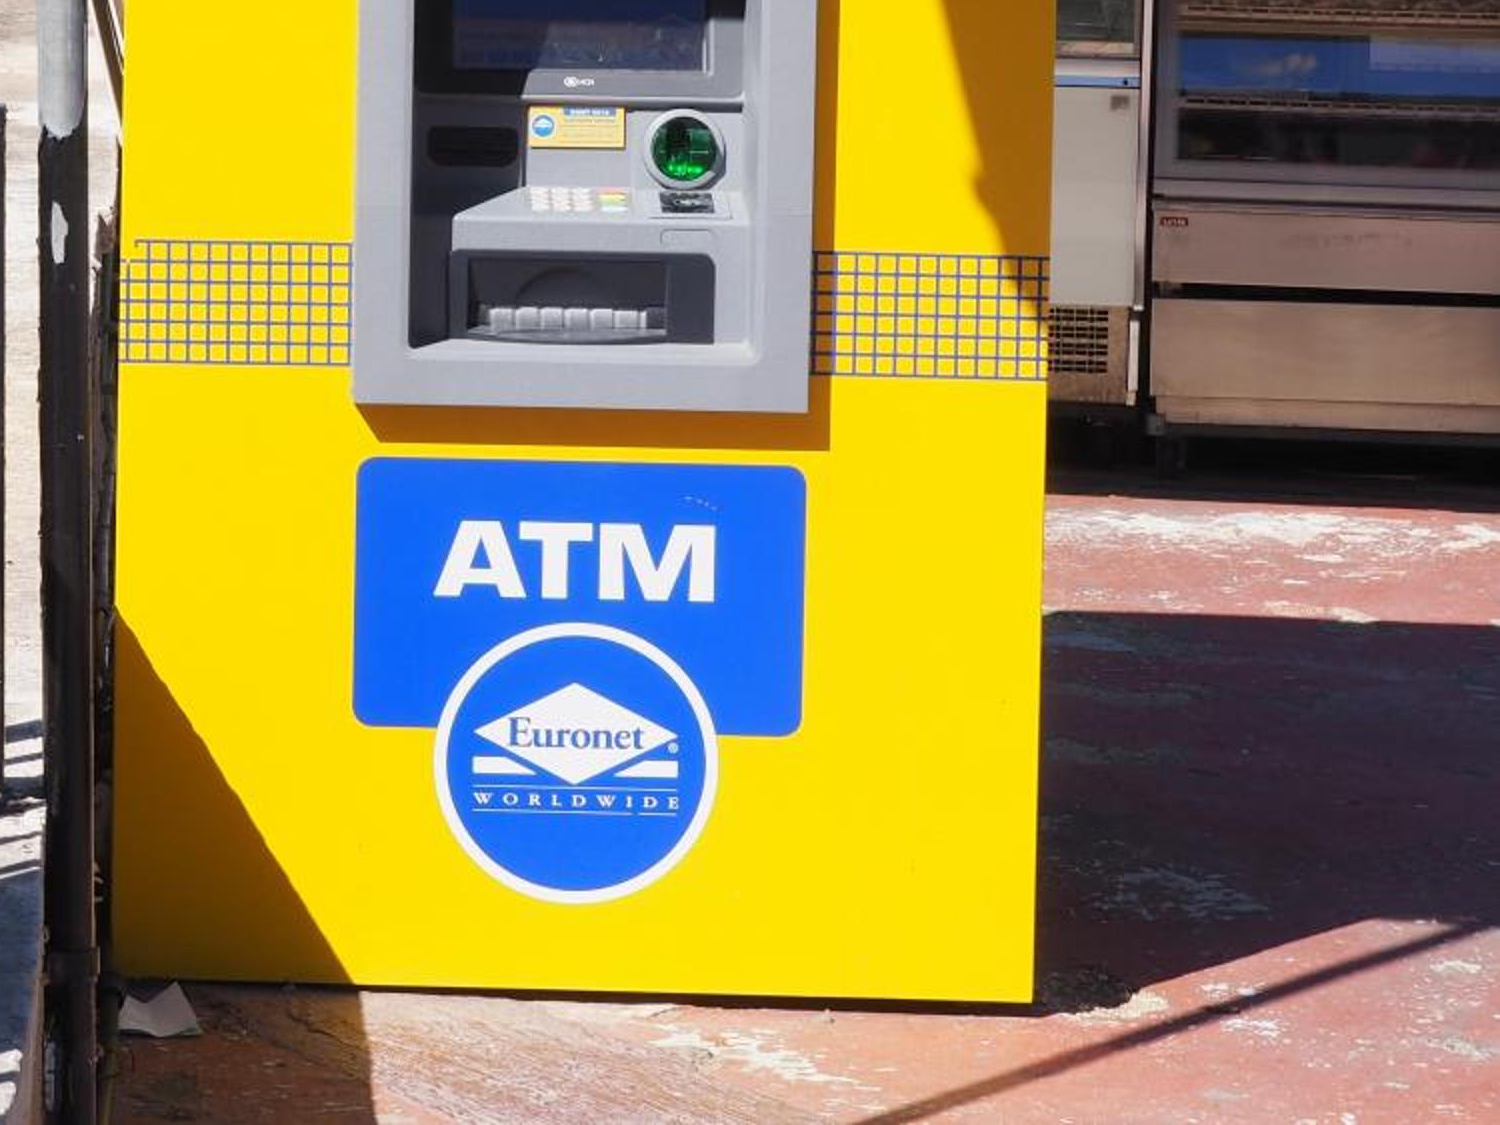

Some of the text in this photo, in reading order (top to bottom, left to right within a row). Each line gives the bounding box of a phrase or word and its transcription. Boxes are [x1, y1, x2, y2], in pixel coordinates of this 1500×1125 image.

[433, 520, 717, 603] ATM
[506, 716, 645, 751] Euronet
[473, 792, 680, 811] WORLDWIDE
